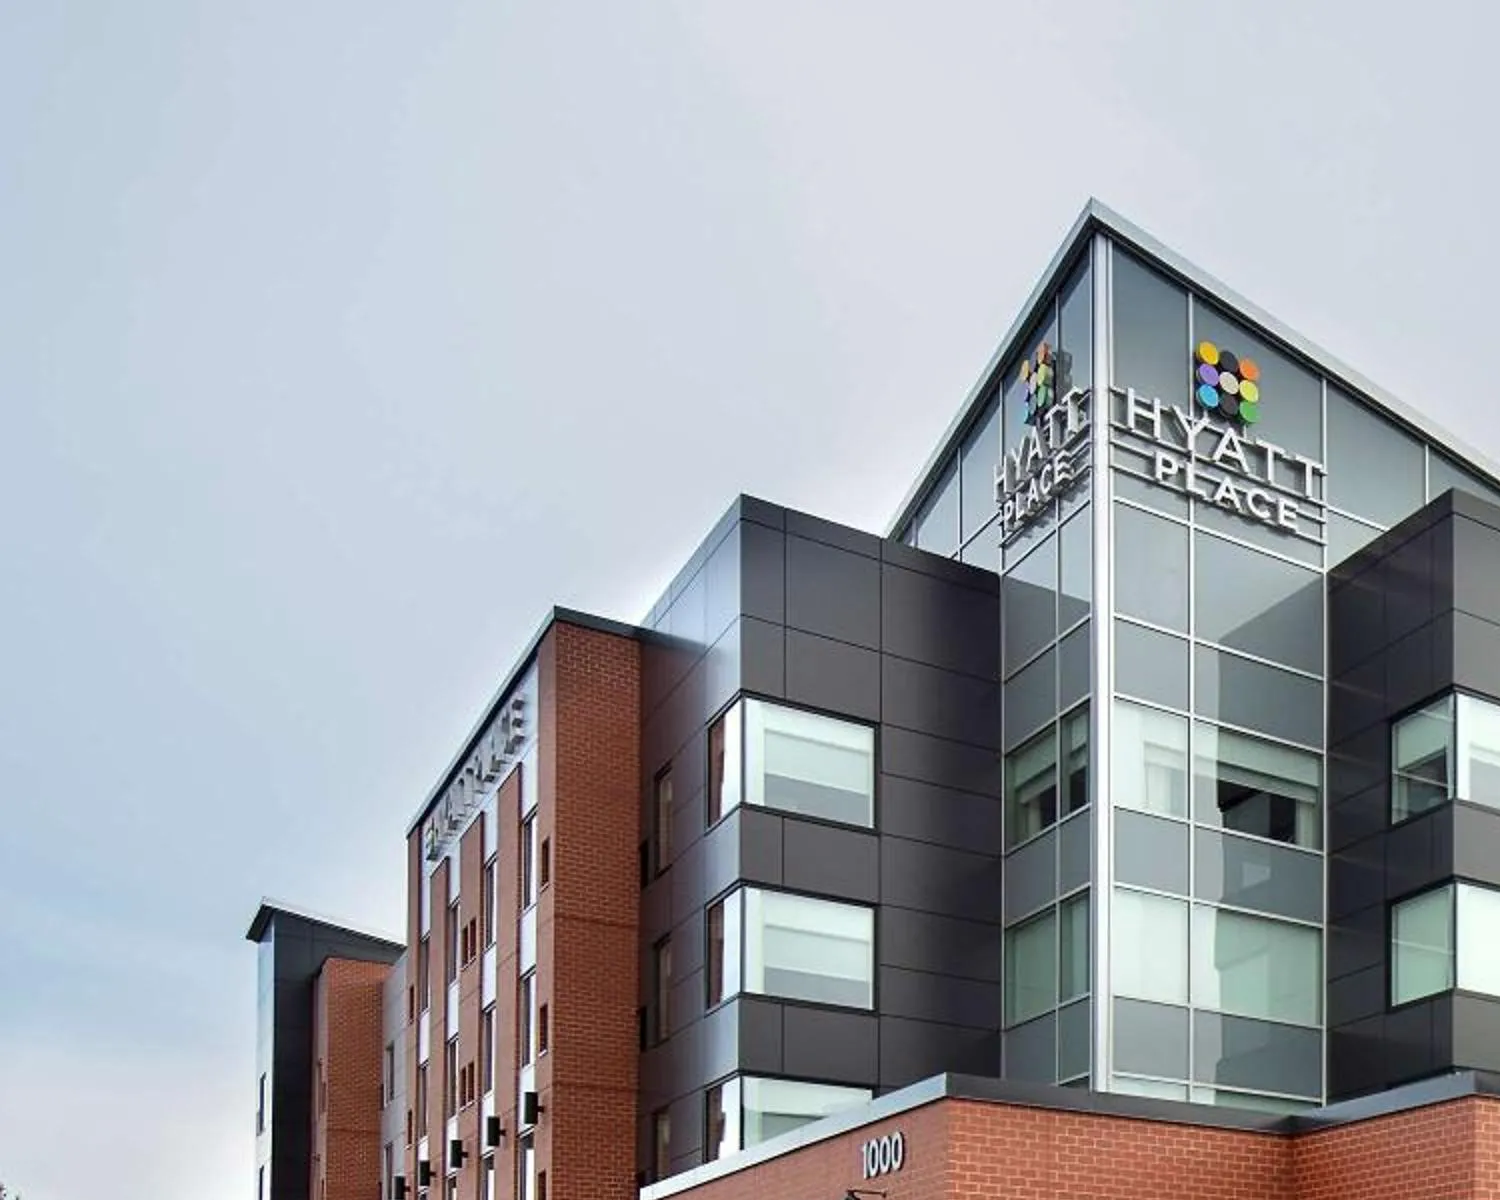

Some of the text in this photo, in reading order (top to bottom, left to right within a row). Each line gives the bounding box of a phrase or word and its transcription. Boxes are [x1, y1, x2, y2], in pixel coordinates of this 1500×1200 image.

[993, 386, 1083, 502] HYATT
[1126, 388, 1326, 498] HYATT
[1003, 449, 1074, 532] PLACE
[1155, 451, 1302, 535] PLACE
[862, 1131, 904, 1180] 1000
